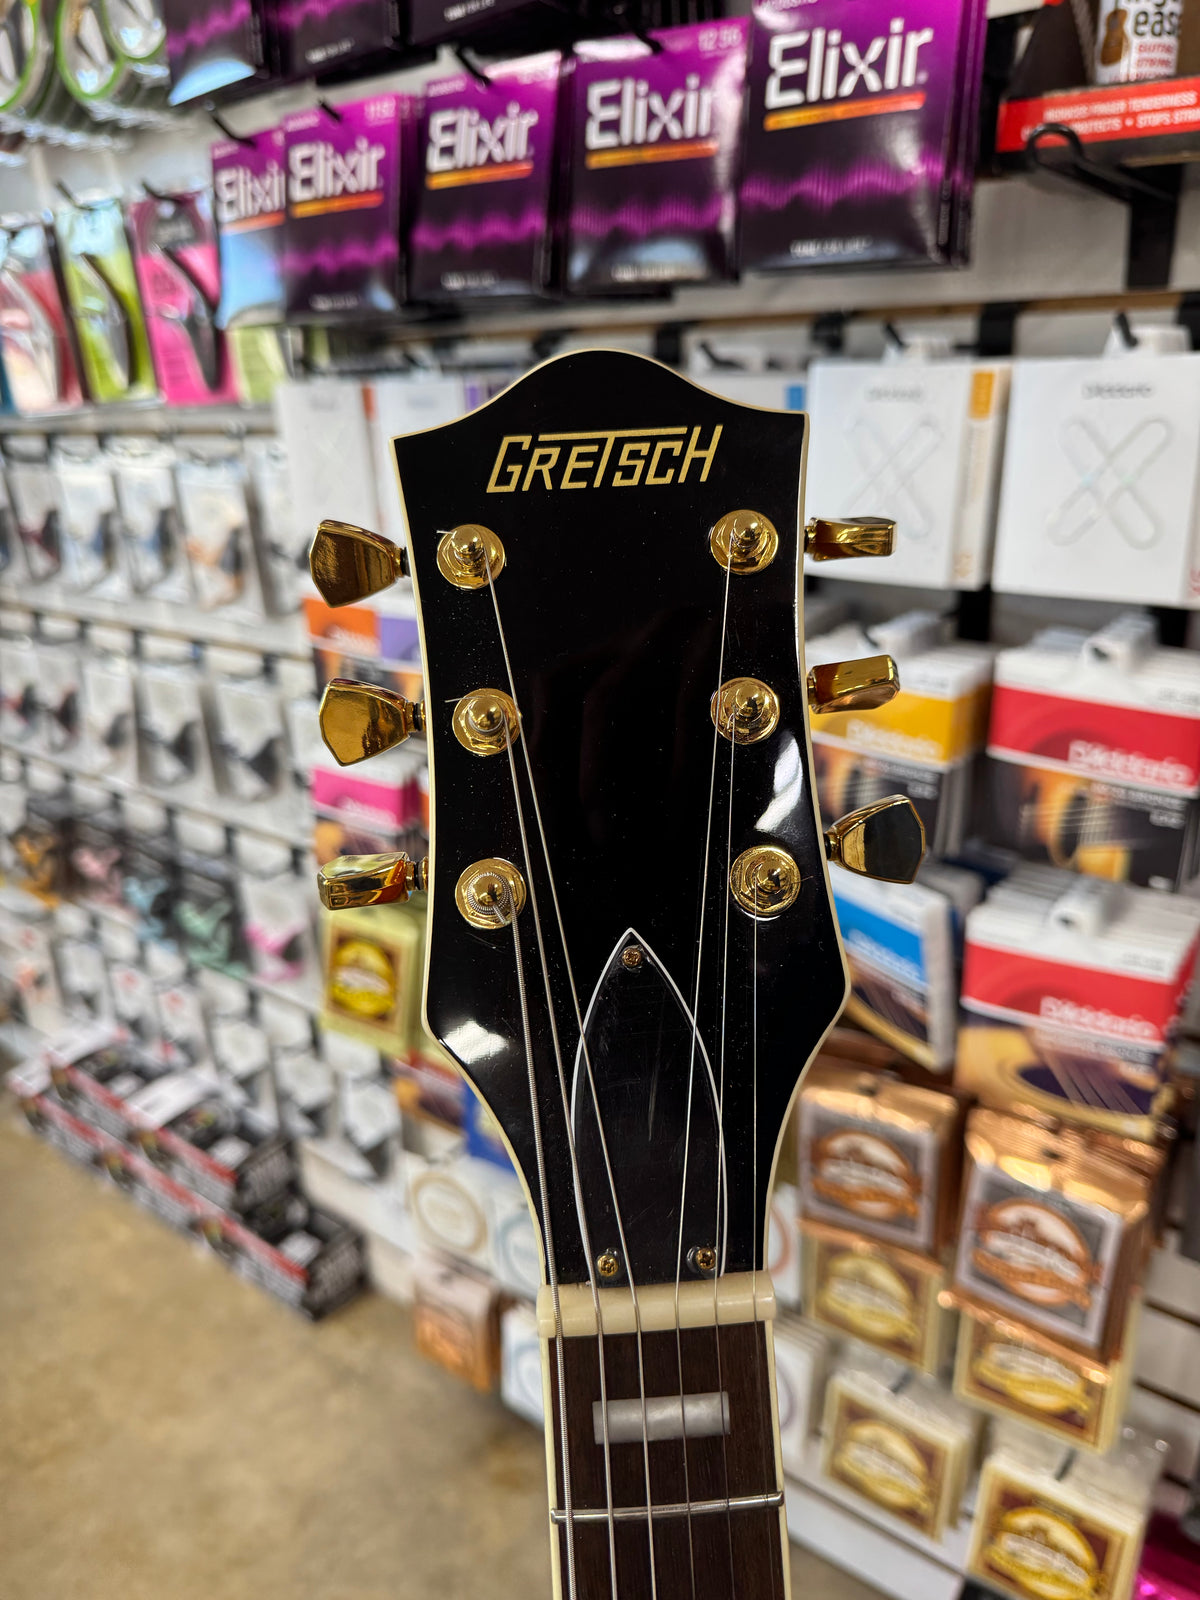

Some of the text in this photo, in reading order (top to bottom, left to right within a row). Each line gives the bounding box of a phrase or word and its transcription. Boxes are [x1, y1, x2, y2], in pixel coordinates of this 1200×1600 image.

[764, 18, 935, 110] Elixir
[426, 101, 539, 173] Elixir
[586, 74, 724, 149] Elixir
[288, 137, 385, 203] Elixir
[486, 424, 723, 493] GRETSCH
